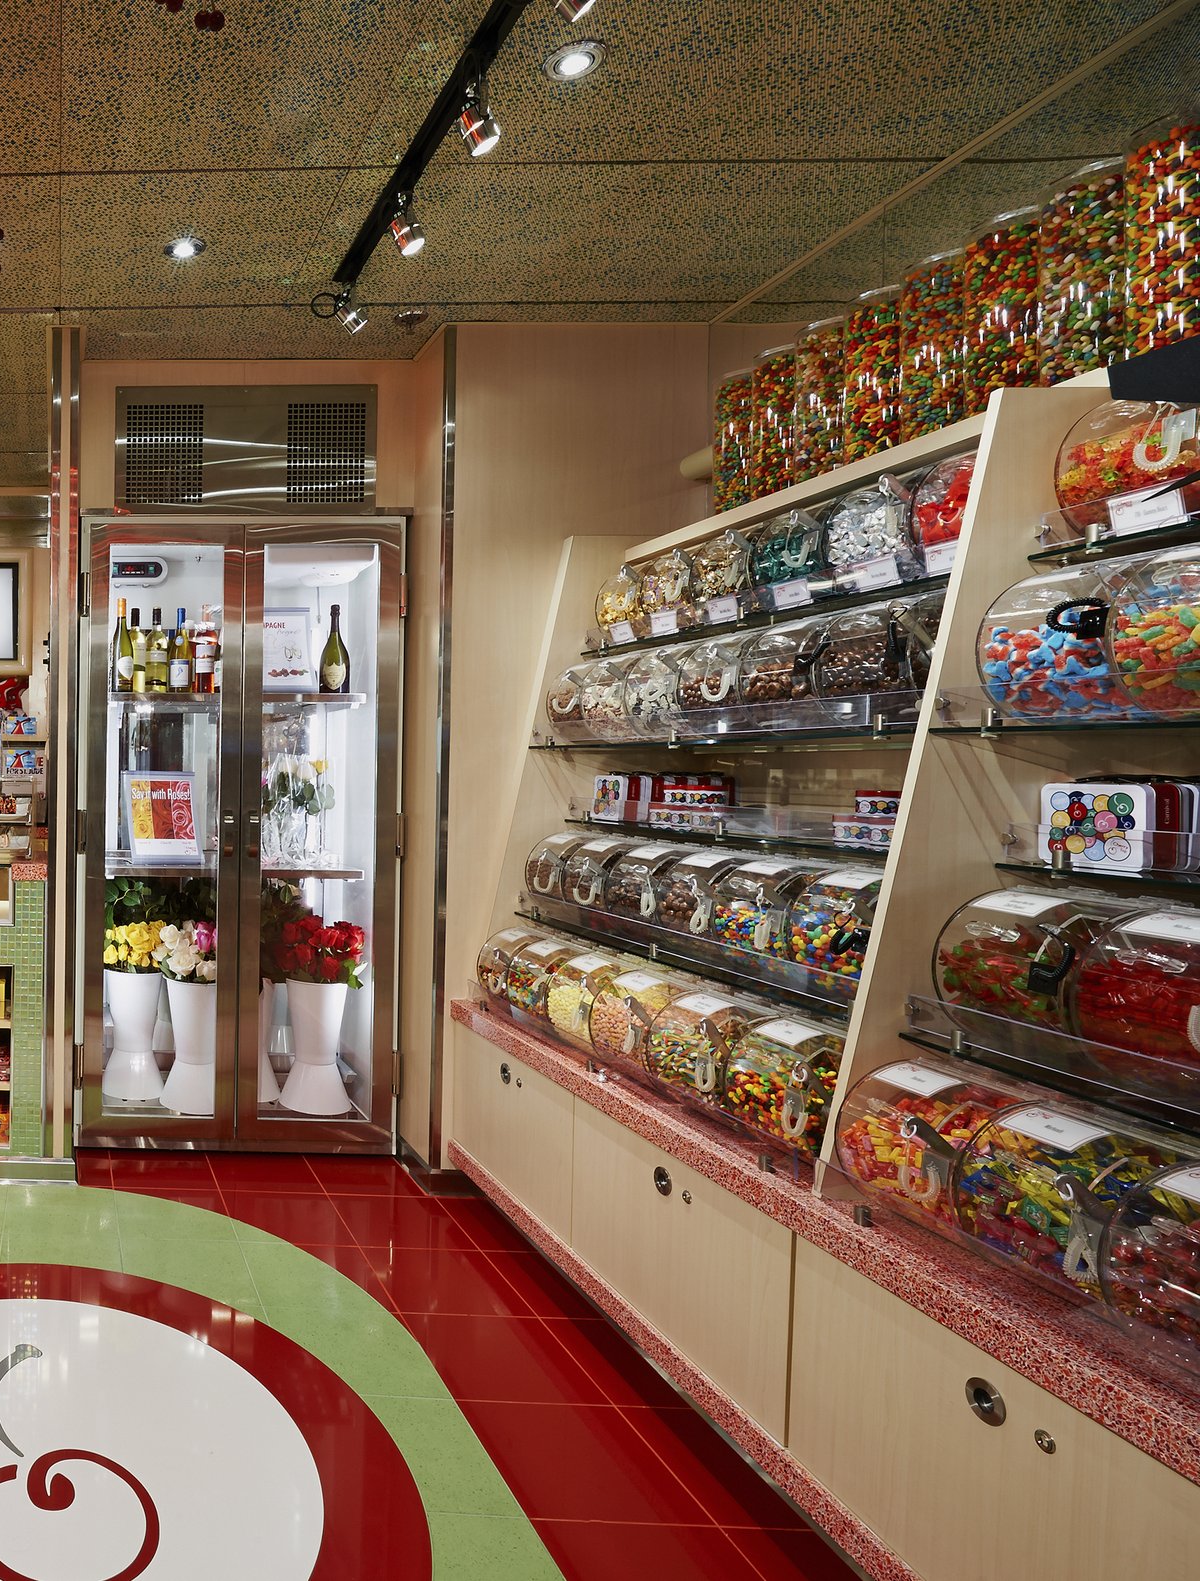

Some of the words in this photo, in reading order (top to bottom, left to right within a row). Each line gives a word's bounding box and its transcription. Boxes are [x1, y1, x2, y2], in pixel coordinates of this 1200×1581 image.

[131, 787, 144, 800] Say
[152, 788, 167, 800] with
[167, 788, 191, 800] Roses!
